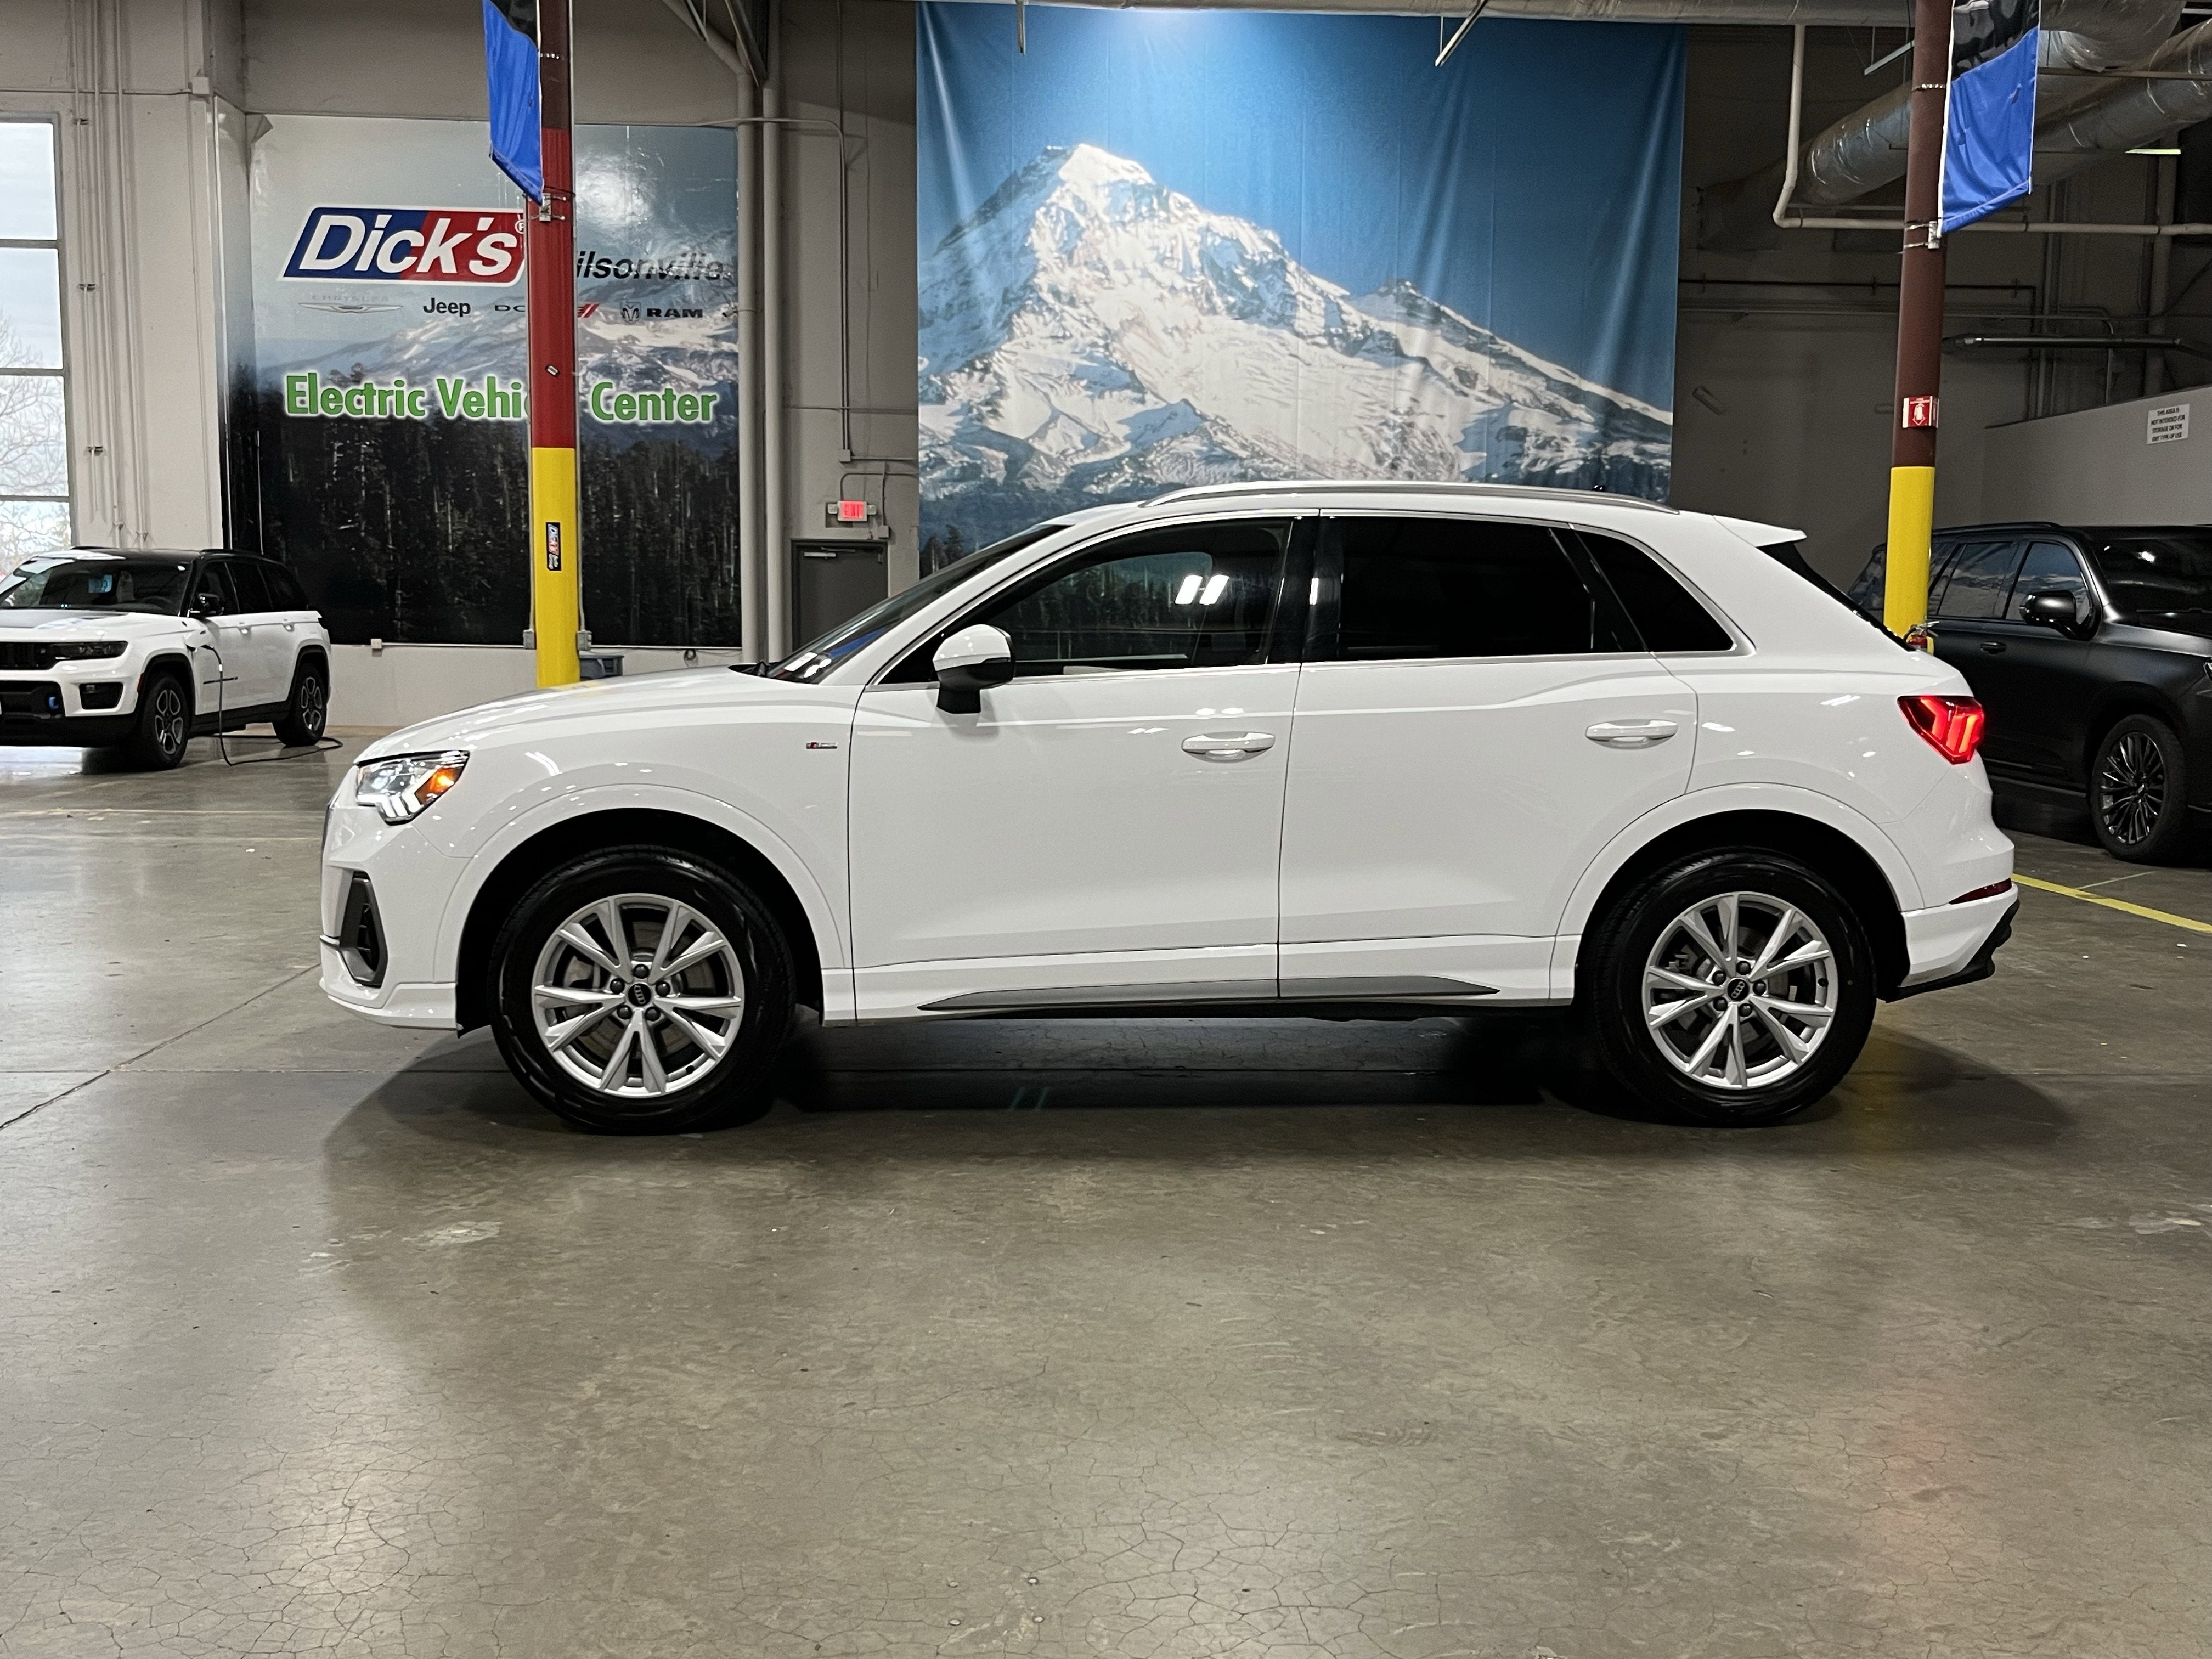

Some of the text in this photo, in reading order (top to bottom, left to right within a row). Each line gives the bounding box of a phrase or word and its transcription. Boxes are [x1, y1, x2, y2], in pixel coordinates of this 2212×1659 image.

[299, 214, 517, 276] Dick's
[577, 250, 723, 280] ilsonville
[423, 297, 471, 317] Jeep
[647, 308, 703, 318] RAM
[286, 373, 717, 421] Electric Vehi Center
